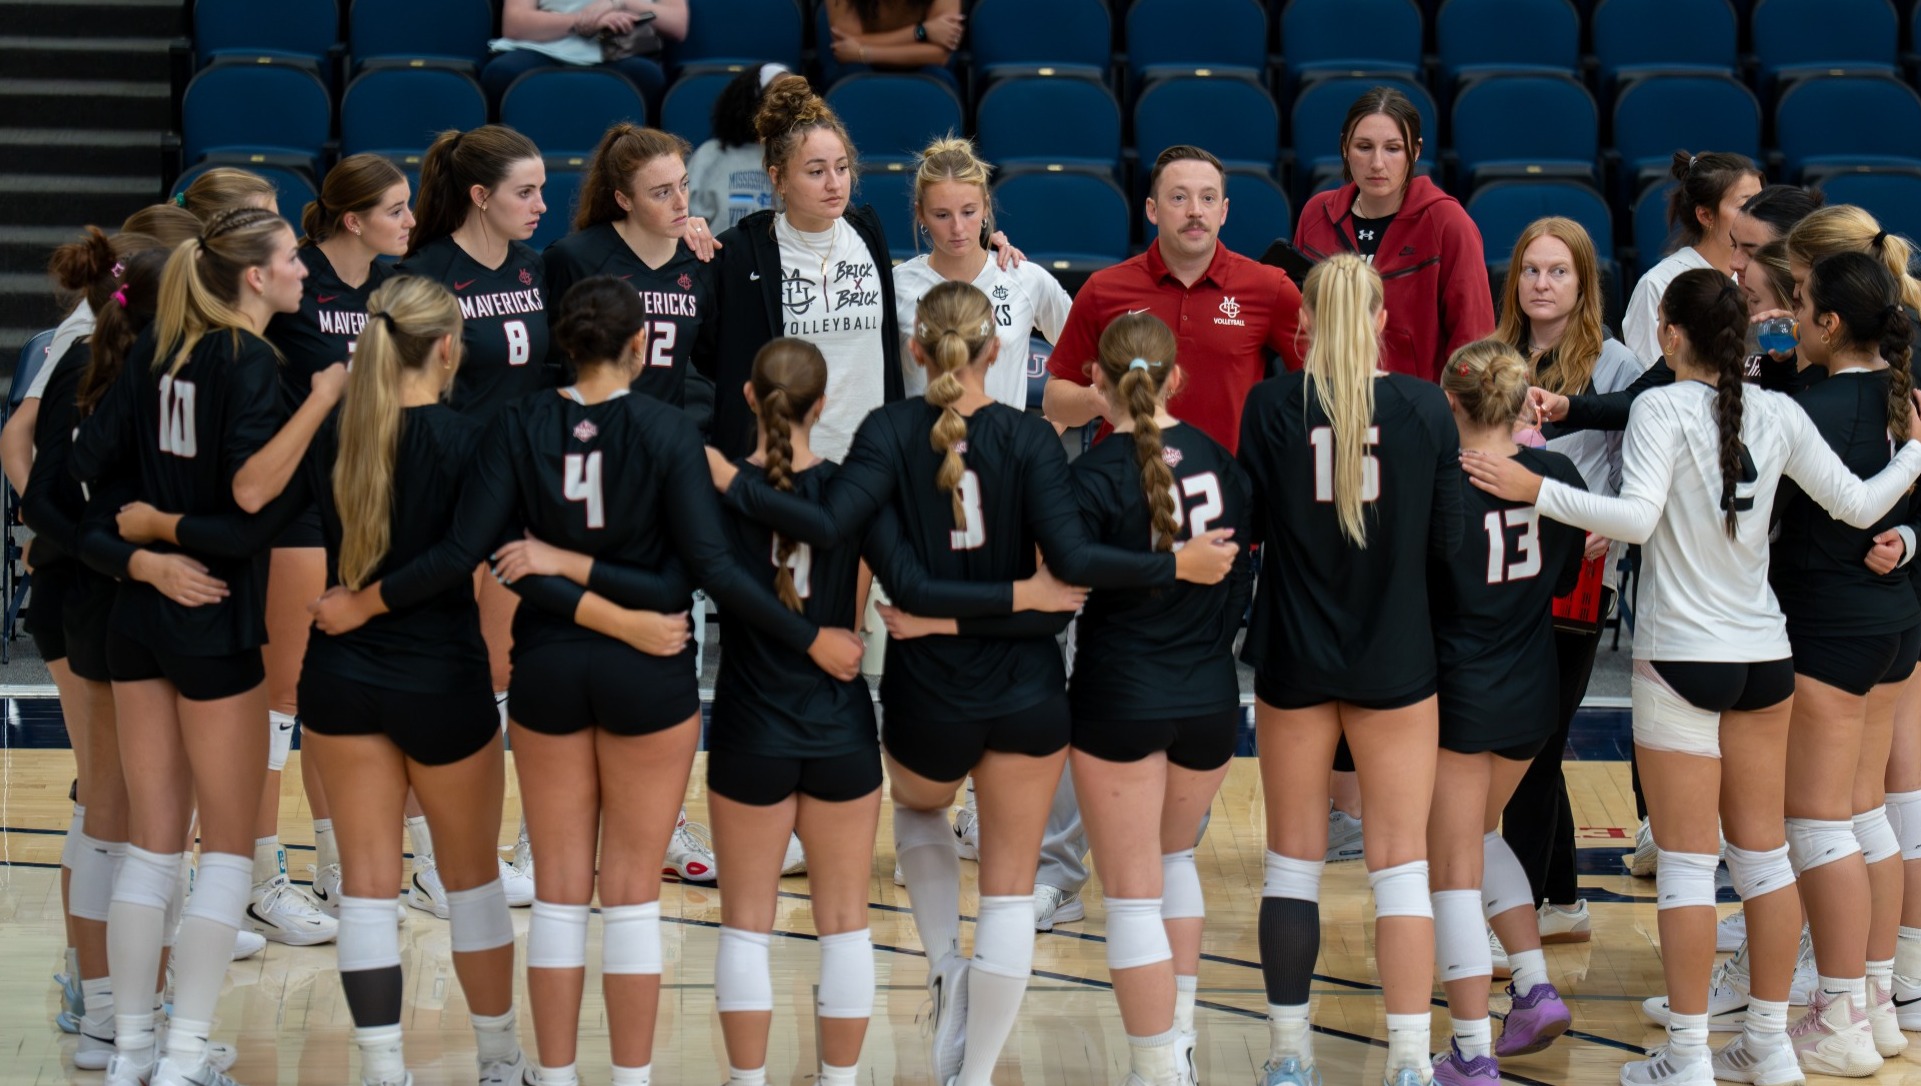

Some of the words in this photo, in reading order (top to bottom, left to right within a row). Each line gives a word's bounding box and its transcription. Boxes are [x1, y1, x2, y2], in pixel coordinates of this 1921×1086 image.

[833, 260, 873, 283] BRICK
[458, 288, 544, 319] MAVERICKS
[835, 289, 879, 311] BRICK
[1213, 317, 1245, 327] VOLLEYBALL
[504, 320, 531, 365] 8
[159, 373, 197, 458] 10
[564, 450, 604, 529] 4
[1484, 505, 1541, 584] 13
